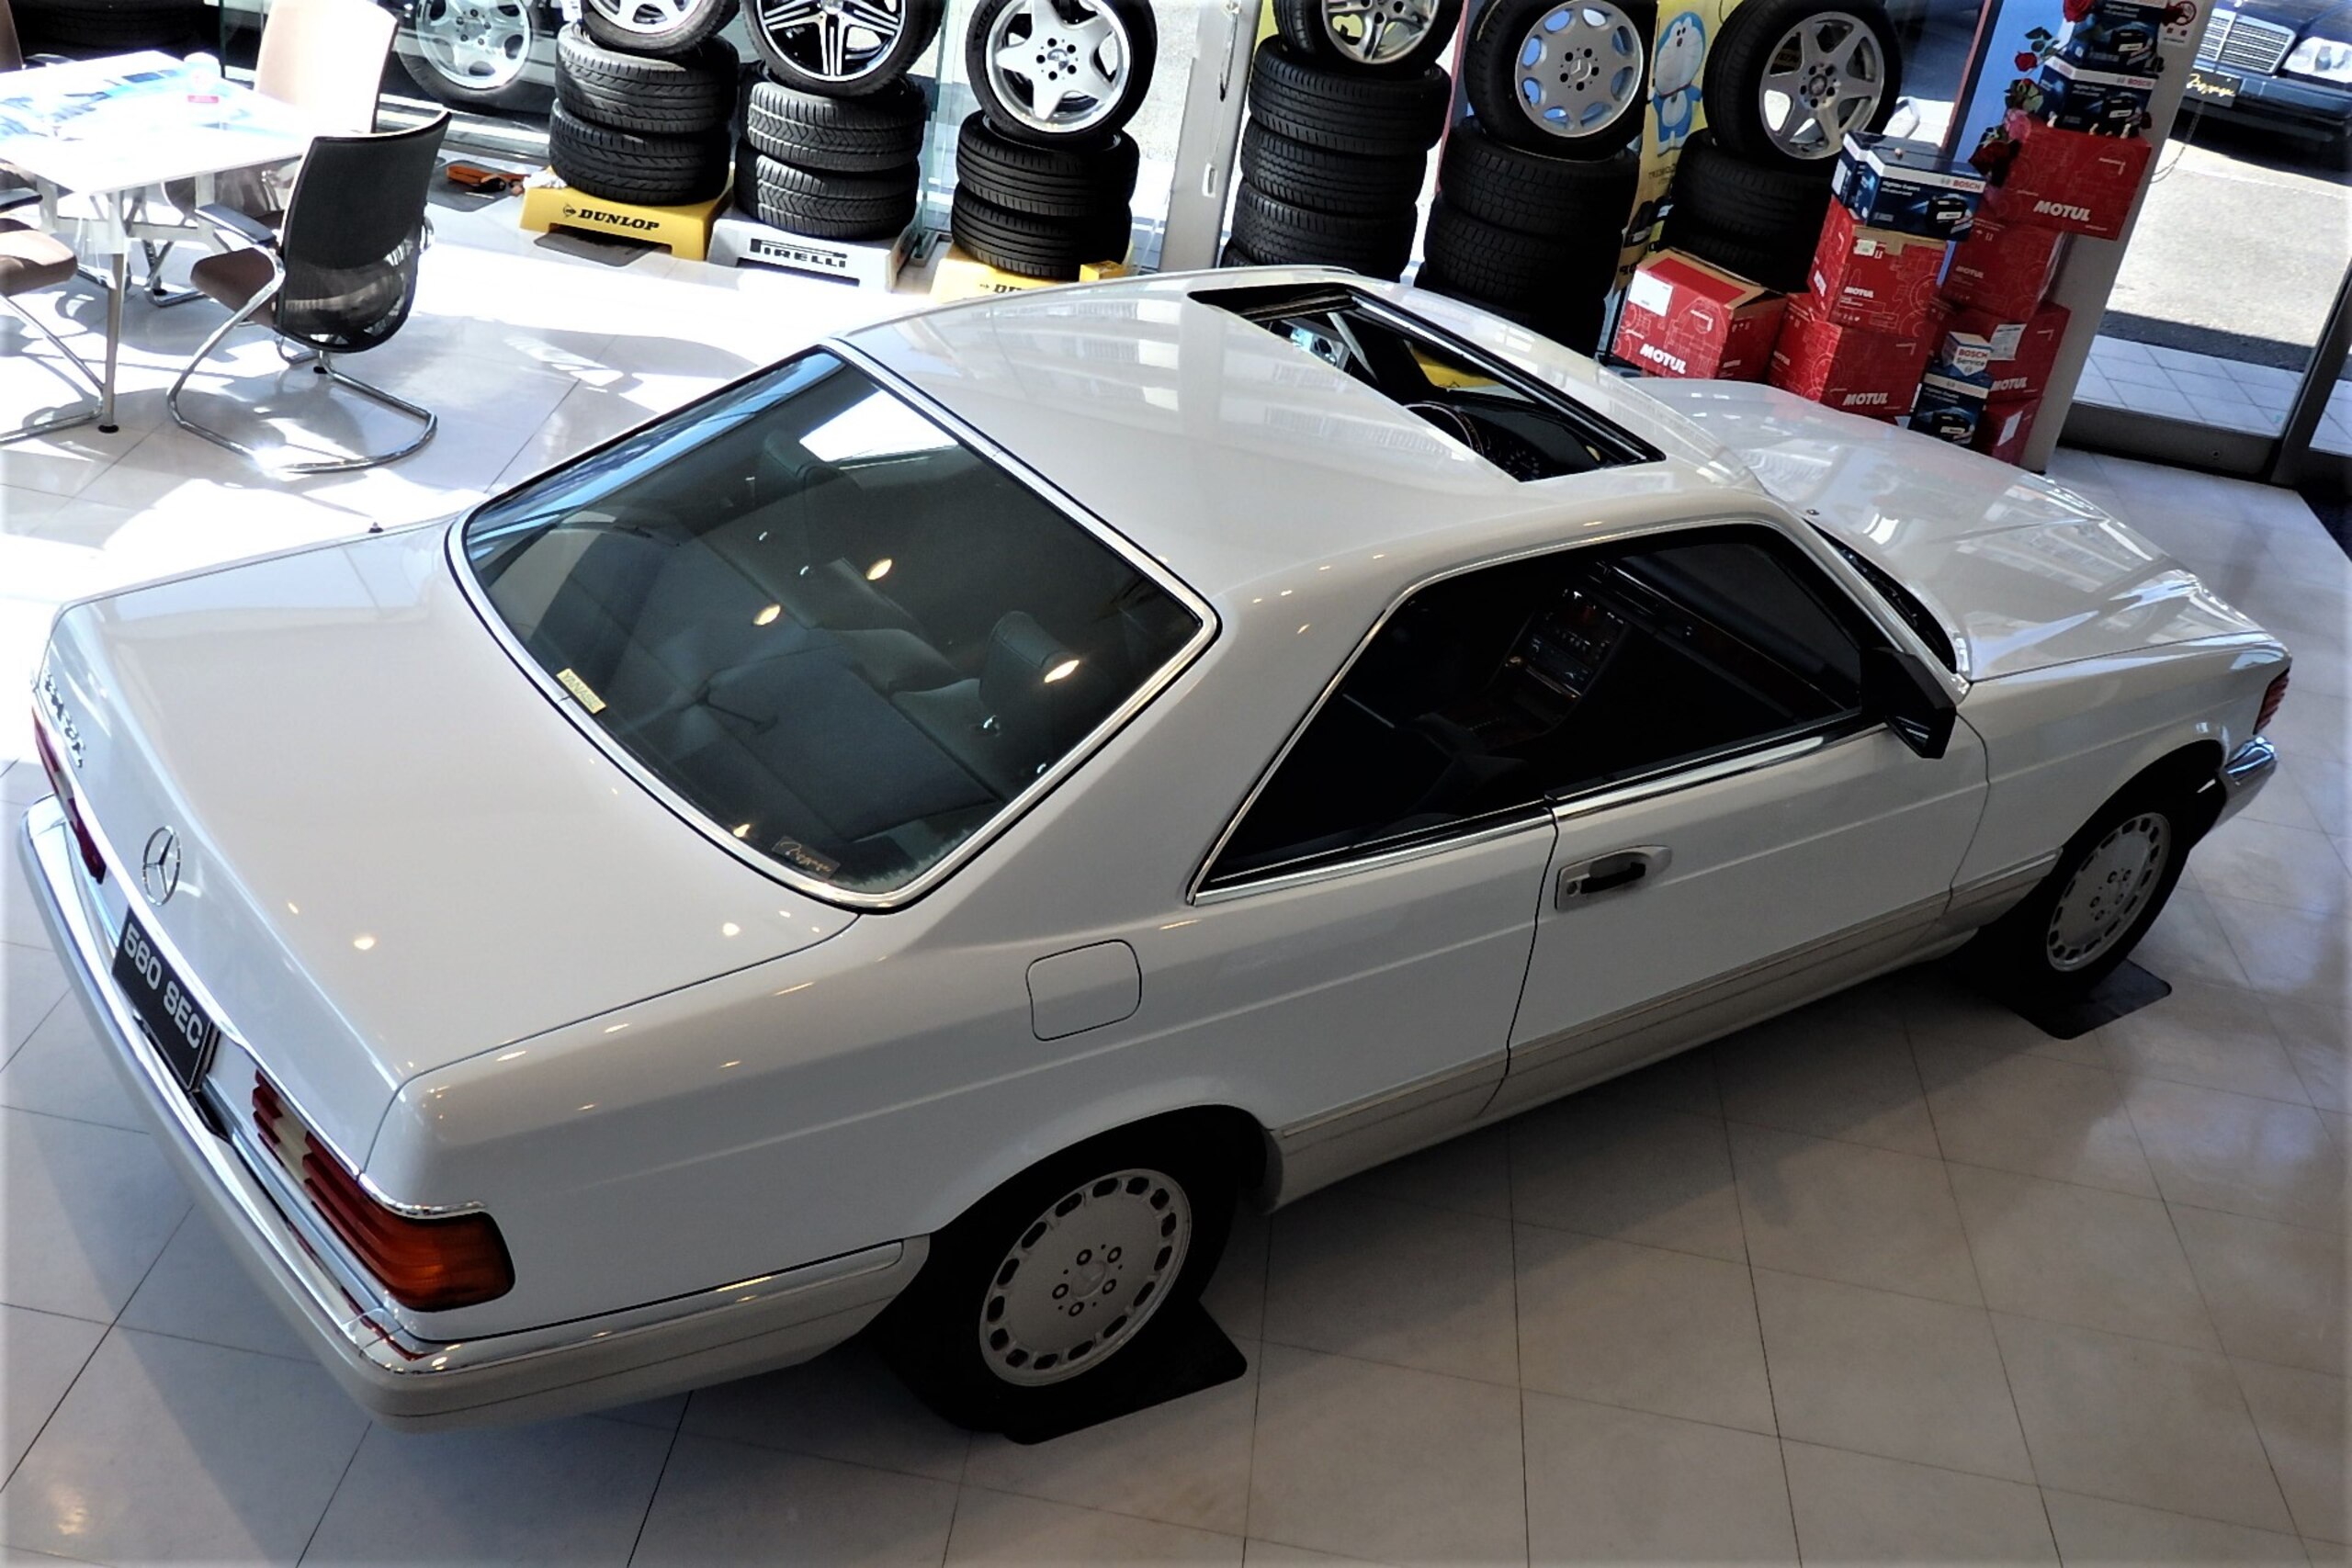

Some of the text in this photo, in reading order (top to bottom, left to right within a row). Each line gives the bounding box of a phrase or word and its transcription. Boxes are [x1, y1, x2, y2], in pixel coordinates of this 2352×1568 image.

[1953, 179, 1981, 190] BOSCH
[2033, 199, 2091, 222] MOTUL
[578, 209, 660, 231] DUNLOP
[750, 238, 848, 267] PIRELLI
[1955, 265, 1984, 278] MOTUL
[1844, 286, 1874, 299] MOTUL
[1639, 343, 1687, 375] MOTUL
[1959, 349, 1987, 358] BOSCH
[1956, 357, 1984, 367] Service
[1990, 377, 2028, 392] MOTUL
[1842, 392, 1888, 406] MOTUL
[123, 922, 203, 1049] 560 SEC
